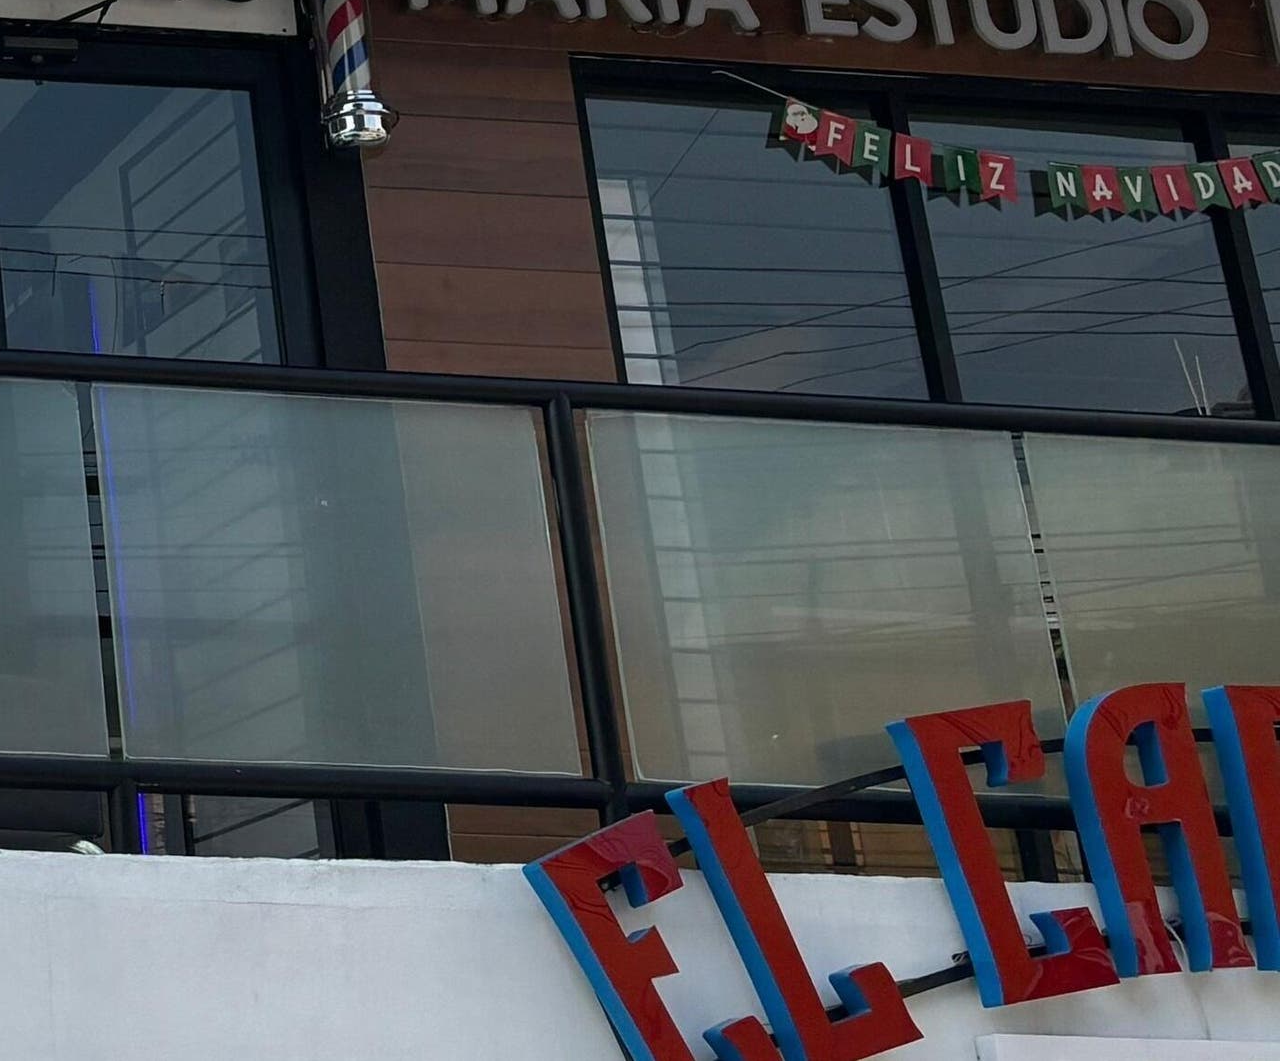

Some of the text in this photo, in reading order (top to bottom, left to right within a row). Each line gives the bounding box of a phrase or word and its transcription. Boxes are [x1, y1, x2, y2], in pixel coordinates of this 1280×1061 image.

[827, 120, 1280, 205] FELIZ NAVIDAD
[522, 777, 925, 1061] EL
